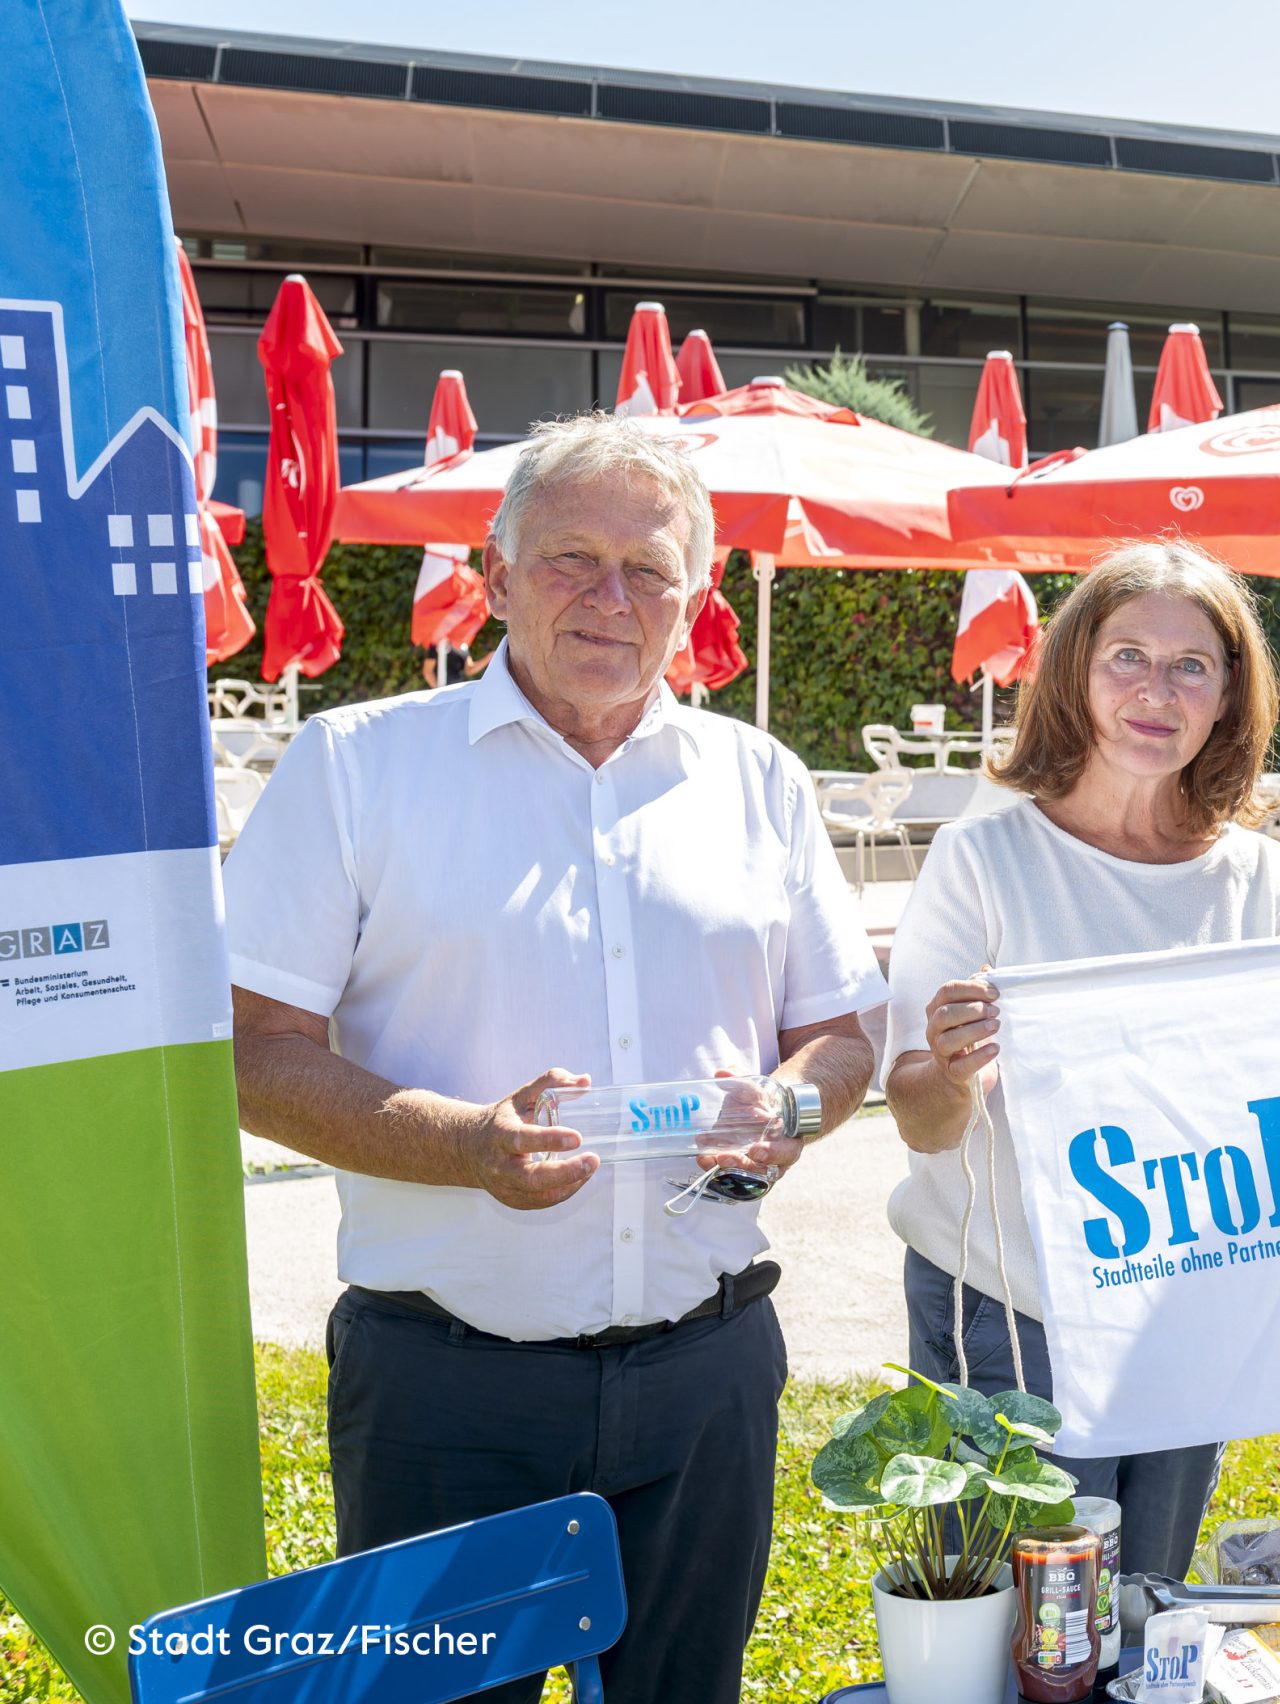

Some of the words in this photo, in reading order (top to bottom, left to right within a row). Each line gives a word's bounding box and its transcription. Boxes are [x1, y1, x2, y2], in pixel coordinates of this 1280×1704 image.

[0, 924, 106, 958] GRAZ
[14, 970, 88, 985] Bundesministerium
[15, 987, 43, 996] Arbeit,
[45, 981, 79, 992] Soziales,
[82, 975, 128, 987] Gesundheit,
[16, 997, 41, 1006] Pflege
[44, 993, 58, 1003] und
[61, 984, 136, 1000] Konsumentenschutz
[1092, 1254, 1176, 1289] Stadtteile
[1181, 1247, 1223, 1273] ohne
[1048, 1572, 1075, 1582] BBQ
[1041, 1584, 1081, 1594] GRILL-SAUCE
